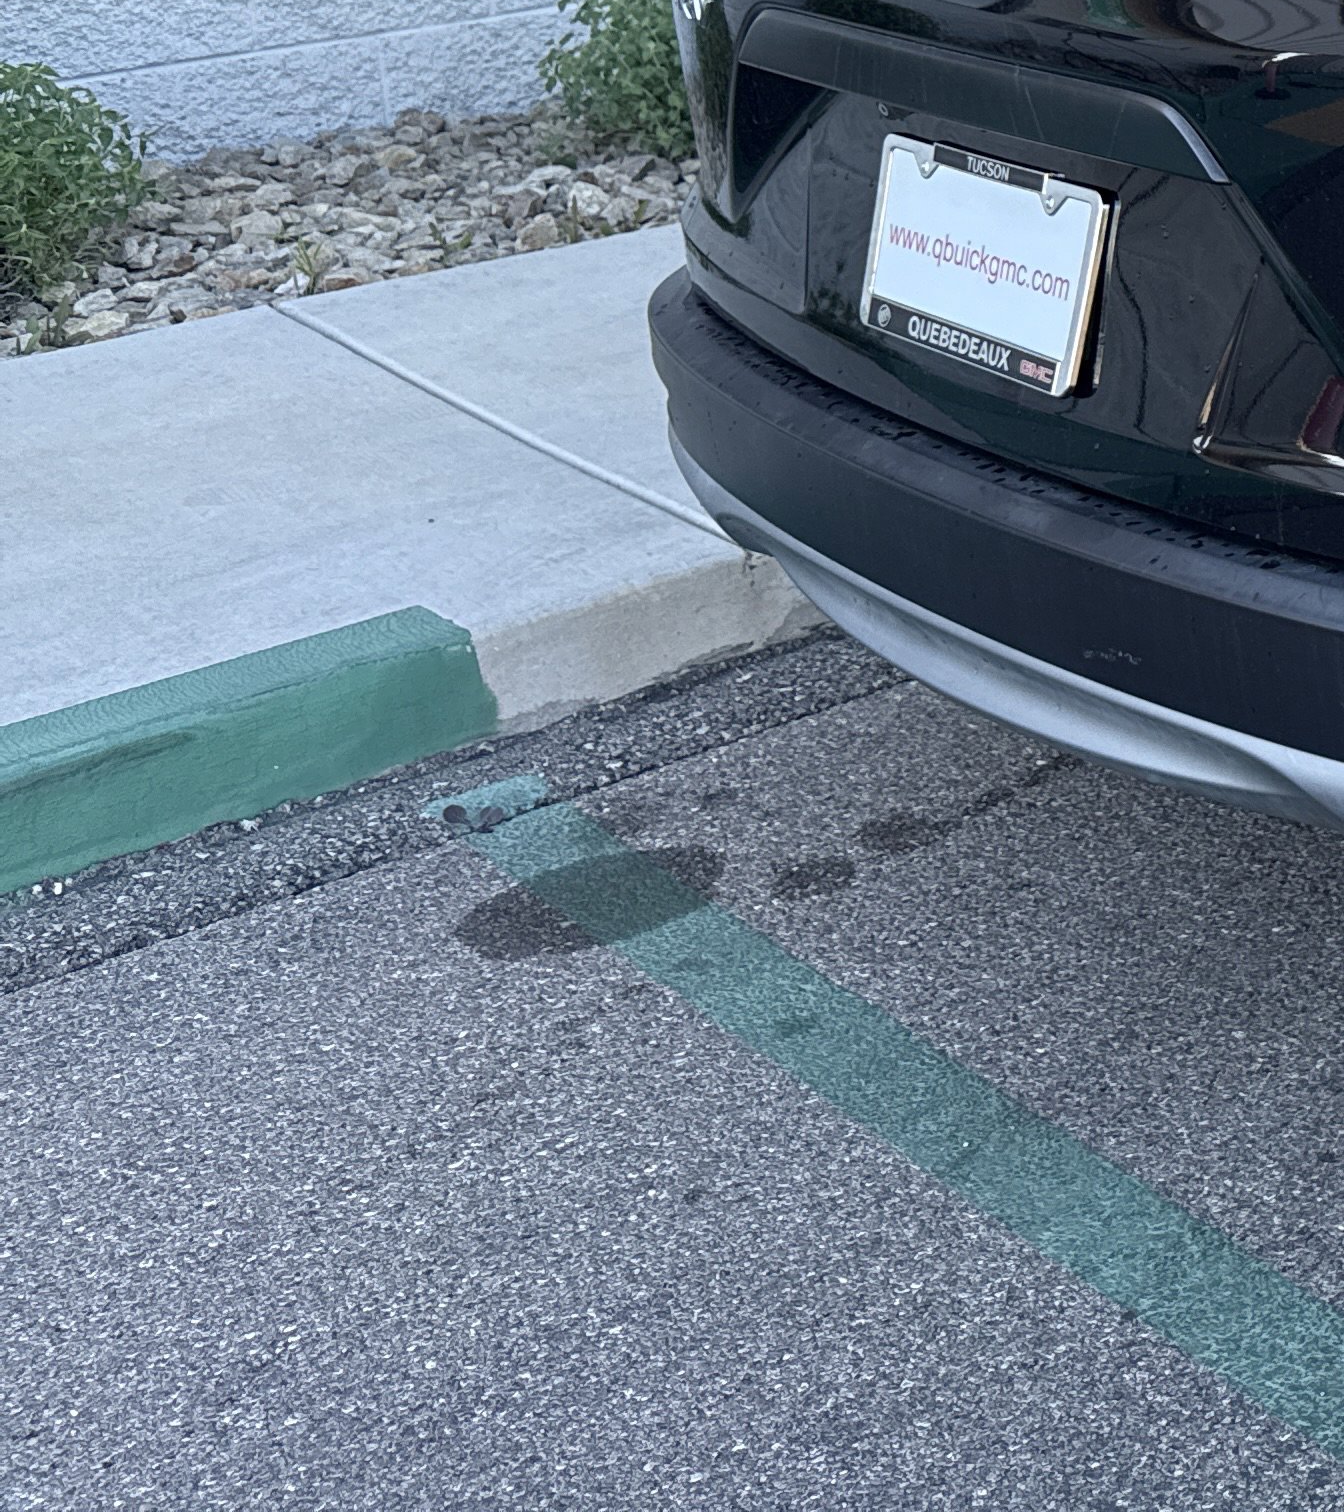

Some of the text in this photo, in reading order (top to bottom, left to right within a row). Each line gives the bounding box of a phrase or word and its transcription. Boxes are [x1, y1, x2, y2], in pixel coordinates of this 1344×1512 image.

[966, 155, 1010, 182] TUCSON
[889, 223, 1070, 301] www.qbuickgmc.com
[907, 315, 1012, 372] QUEBEDEAUX
[1019, 359, 1054, 384] GMC
